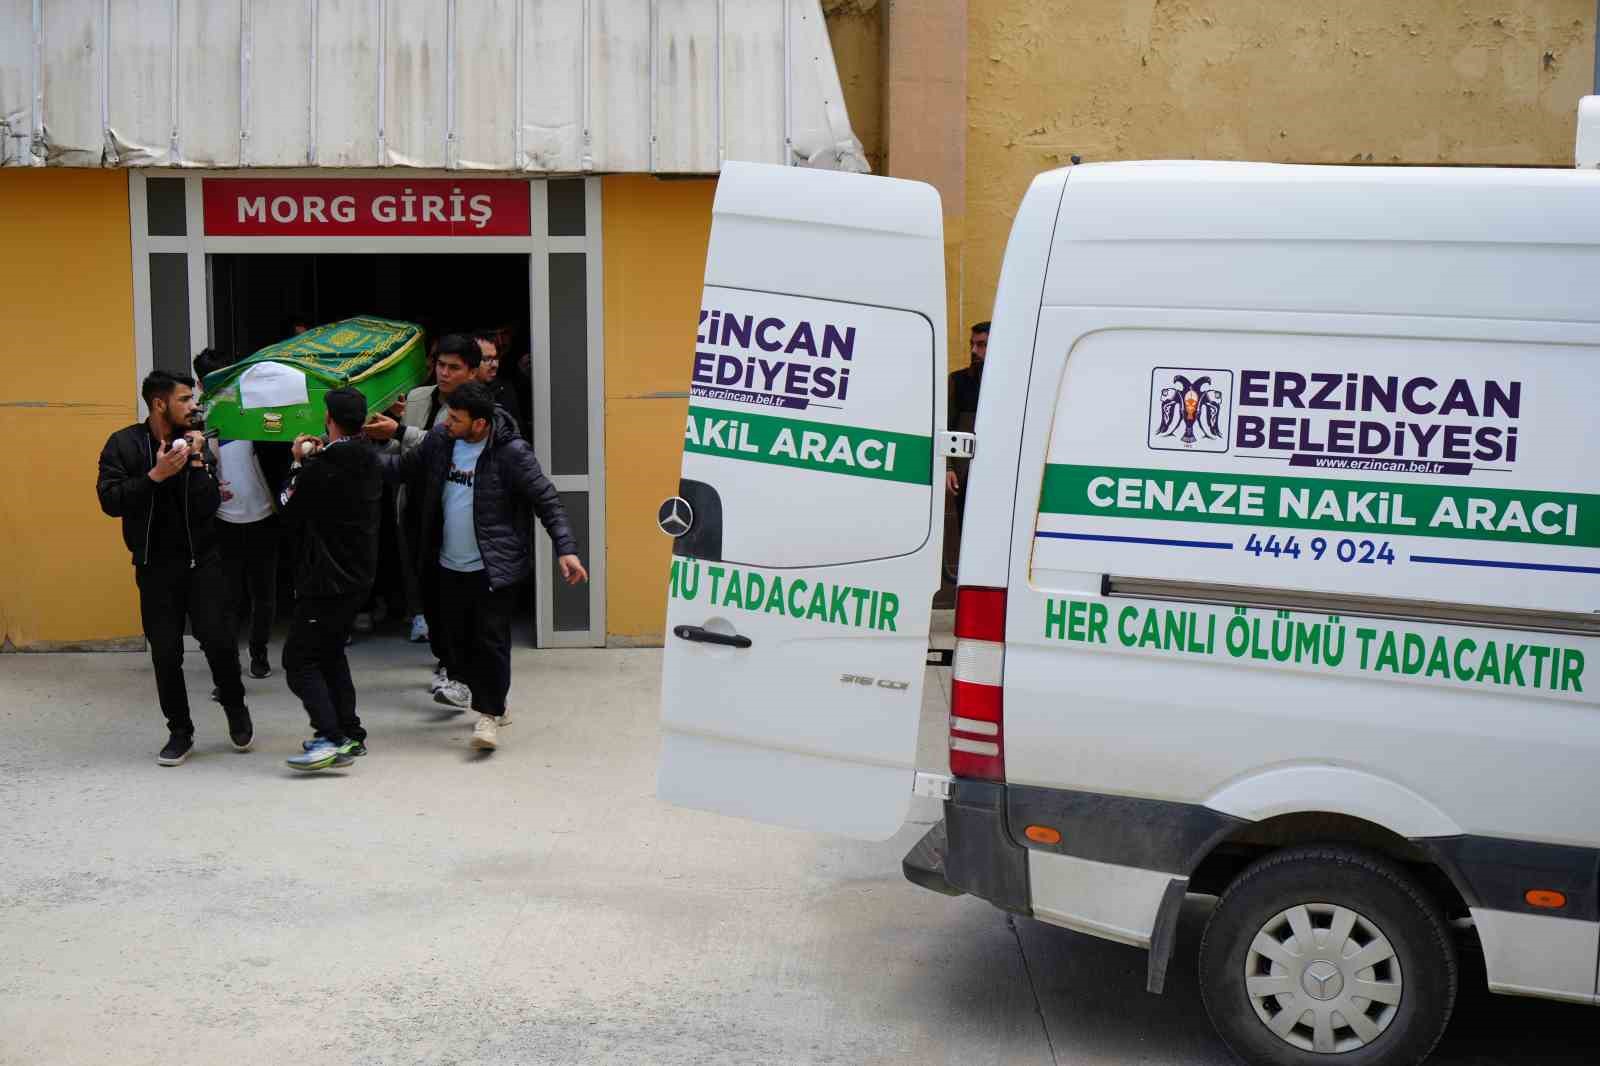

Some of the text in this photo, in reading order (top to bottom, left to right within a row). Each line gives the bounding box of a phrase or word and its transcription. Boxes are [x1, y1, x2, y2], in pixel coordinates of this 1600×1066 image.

[237, 188, 492, 229] MORG GİRİŞ
[769, 427, 897, 471] ARACI
[1315, 457, 1445, 474] www.erzincan.bel.tr
[1087, 476, 1266, 517] CENAZE
[1429, 496, 1578, 536] ARACI
[1244, 533, 1396, 566] 444 9 024
[707, 565, 901, 632] TADACAKTIR
[1044, 596, 1586, 693] HER CANLI ÖLÜMÜ TADACAKTIR
